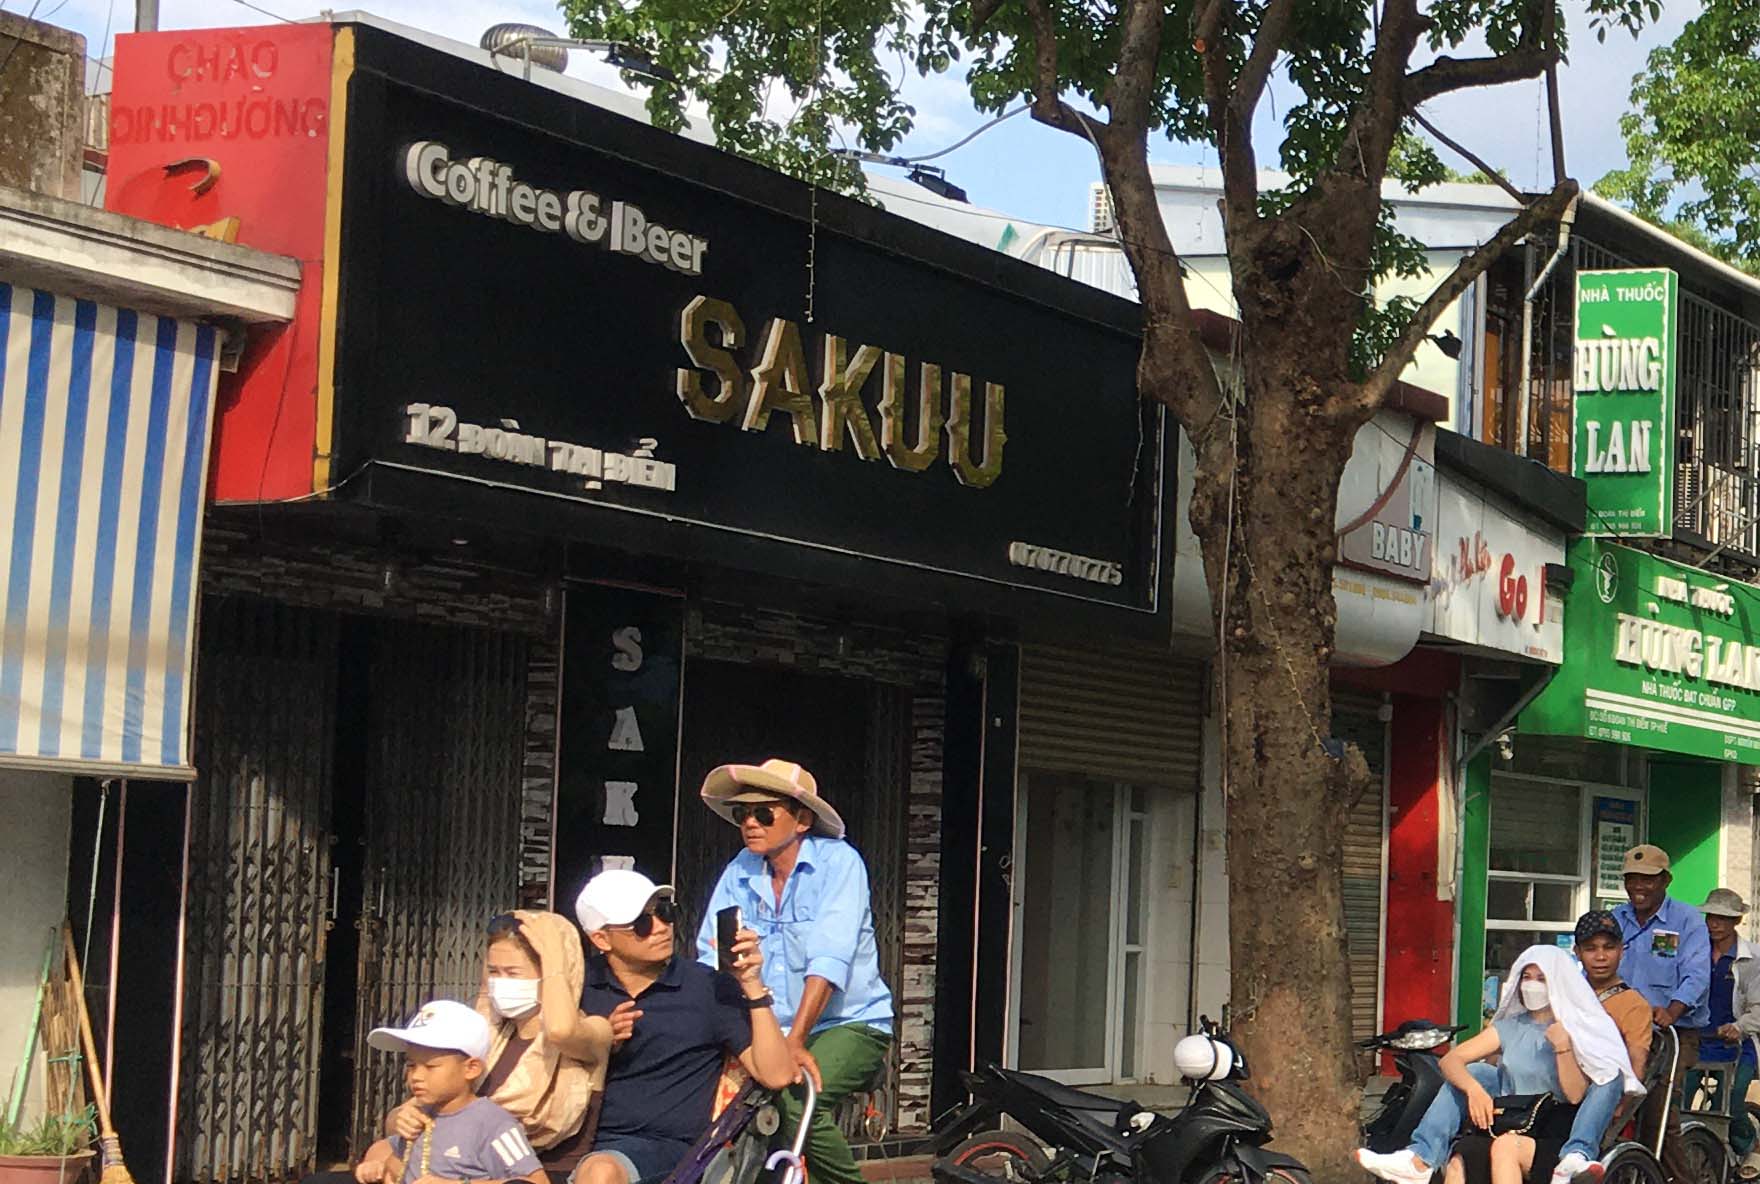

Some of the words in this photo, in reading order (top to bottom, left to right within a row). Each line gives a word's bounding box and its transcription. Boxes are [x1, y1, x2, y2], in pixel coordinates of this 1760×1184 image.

[406, 141, 561, 232] Coffee
[565, 190, 608, 243] &
[610, 201, 708, 276] Beer
[1581, 284, 1610, 303] NHÀ
[1616, 281, 1664, 302] THUỐC
[1574, 323, 1661, 391] HÙNG
[677, 295, 1008, 488] SAKUU
[405, 402, 458, 450] 12
[1584, 420, 1653, 473] LAN
[1371, 521, 1426, 571] BABY
[1615, 601, 1704, 678] HÙNG
